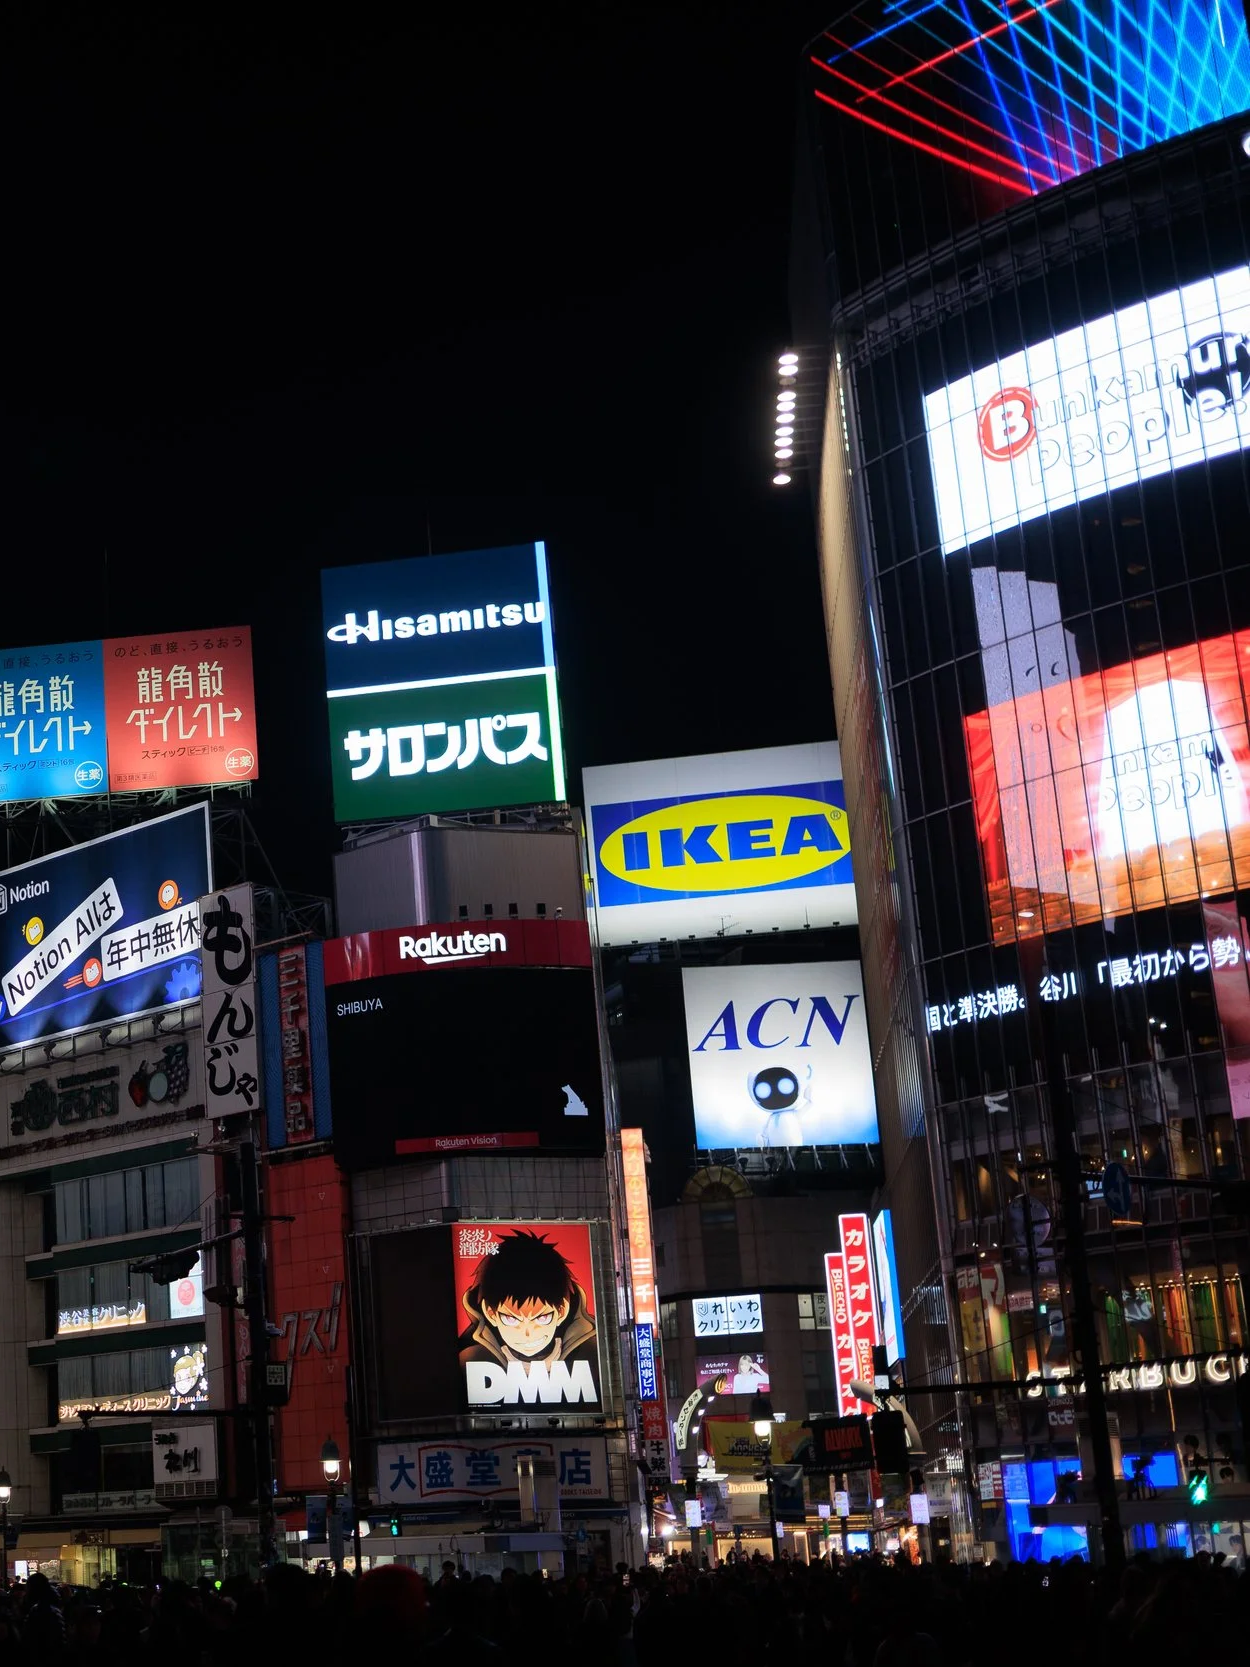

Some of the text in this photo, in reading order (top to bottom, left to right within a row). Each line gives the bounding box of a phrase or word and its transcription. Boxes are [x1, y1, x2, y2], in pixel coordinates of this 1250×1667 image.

[989, 333, 1250, 451] Bunkamur
[326, 601, 545, 644] Hisamitsu
[114, 636, 243, 659] のど、直接、うるおう
[137, 661, 224, 704] 龍角散
[126, 703, 242, 743] ダイレクト
[227, 755, 252, 769] 生薬
[344, 712, 548, 781] サロンパス
[77, 768, 101, 782] 生薬
[622, 813, 843, 871] IKEA
[10, 880, 49, 905] Notion
[106, 914, 200, 970] 年中無休
[399, 930, 507, 961] Rakuten
[7, 936, 72, 1006] Notion
[1040, 972, 1077, 1001] 谷川
[1098, 935, 1250, 988] 「最初から勢
[202, 894, 258, 1106] もんじゃ
[337, 998, 383, 1017] SHIBUYA
[280, 953, 307, 1133] 三千里薬品
[692, 994, 860, 1052] ACN
[435, 1135, 497, 1148] Rakuten Vision
[459, 1229, 492, 1242] 炎炎ノ
[459, 1241, 499, 1256] 消防隊
[845, 1228, 873, 1328] カラオケ
[698, 1317, 760, 1333] クリニック
[712, 1299, 759, 1315] れいわ
[279, 1281, 344, 1400] クスリ
[466, 1360, 598, 1404] DMM
[638, 1328, 654, 1397] 大盛堂商事ビル
